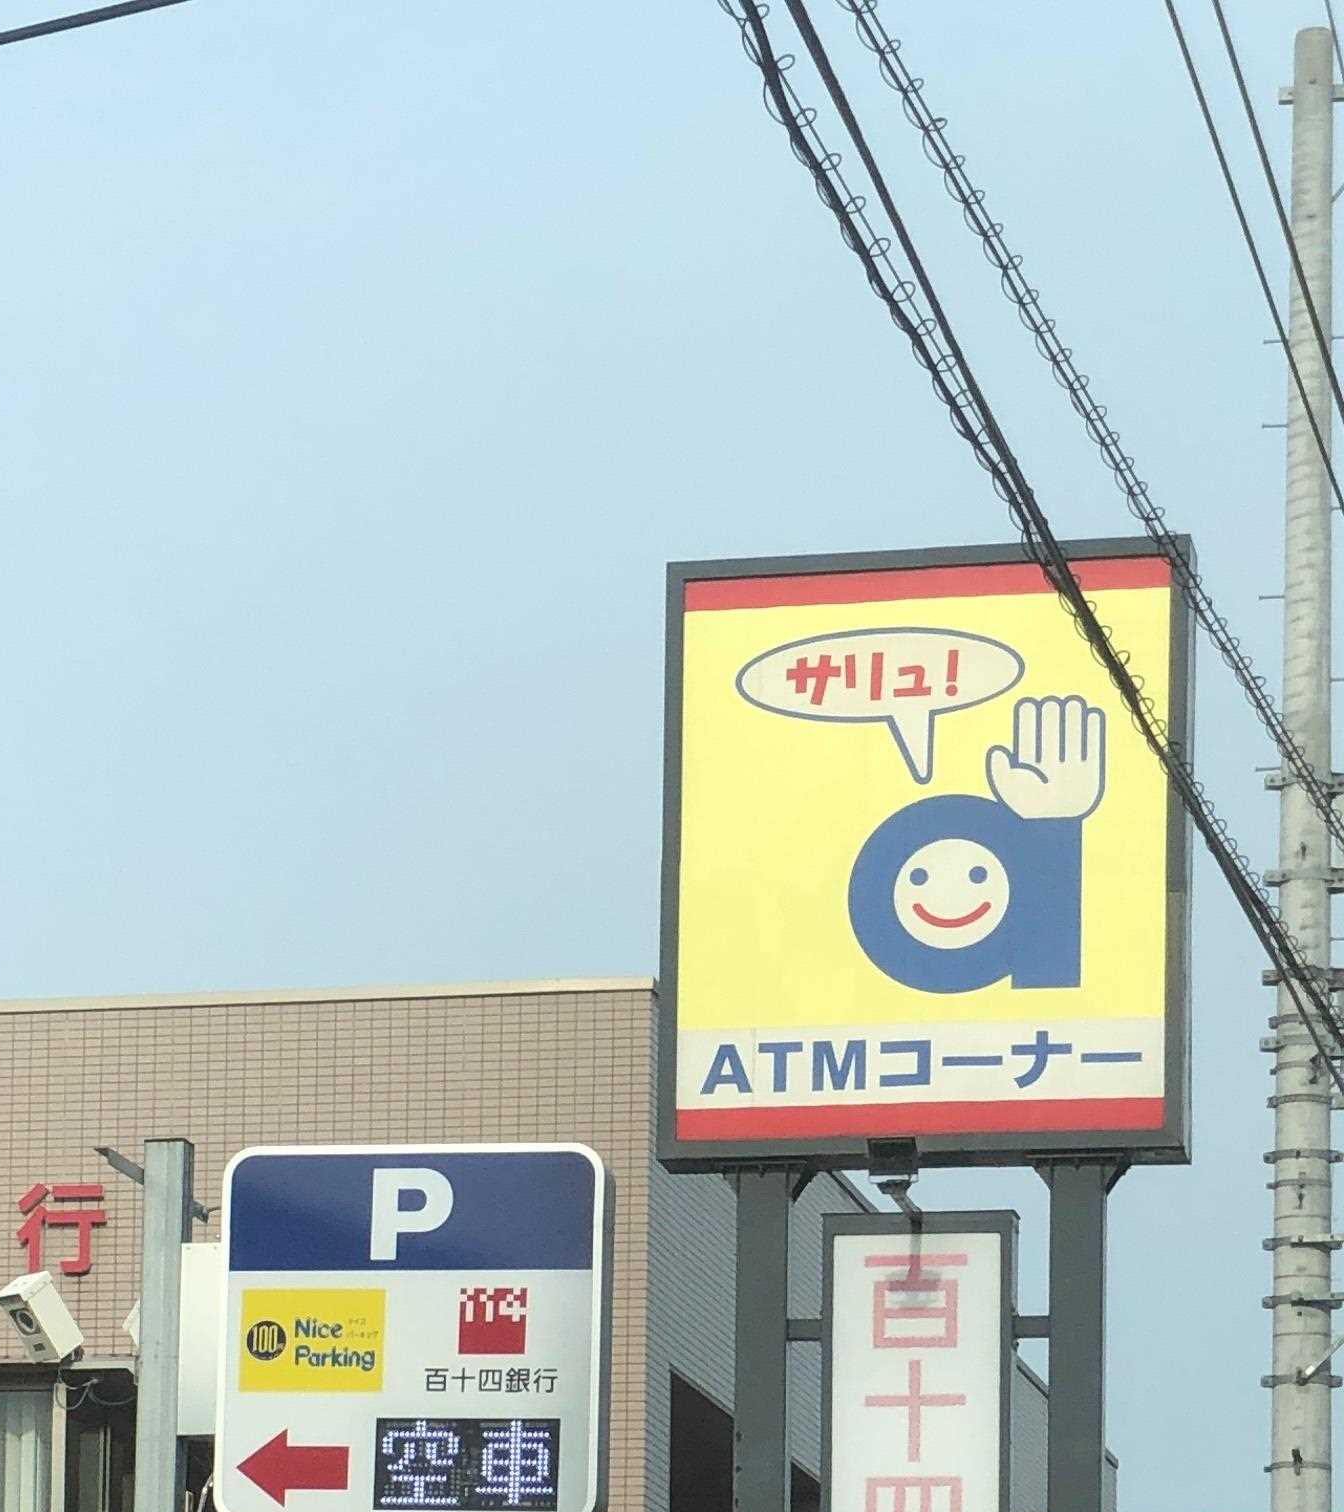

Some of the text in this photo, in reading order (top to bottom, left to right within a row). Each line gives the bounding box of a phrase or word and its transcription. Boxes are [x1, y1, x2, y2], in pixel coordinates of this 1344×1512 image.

[700, 1030, 1143, 1095] ATMコーナー
[370, 1167, 454, 1261] P
[294, 1317, 343, 1339] Nice
[294, 1345, 376, 1372] Parking
[424, 1366, 559, 1393] 百十四銀行
[378, 1419, 555, 1505] 空車
